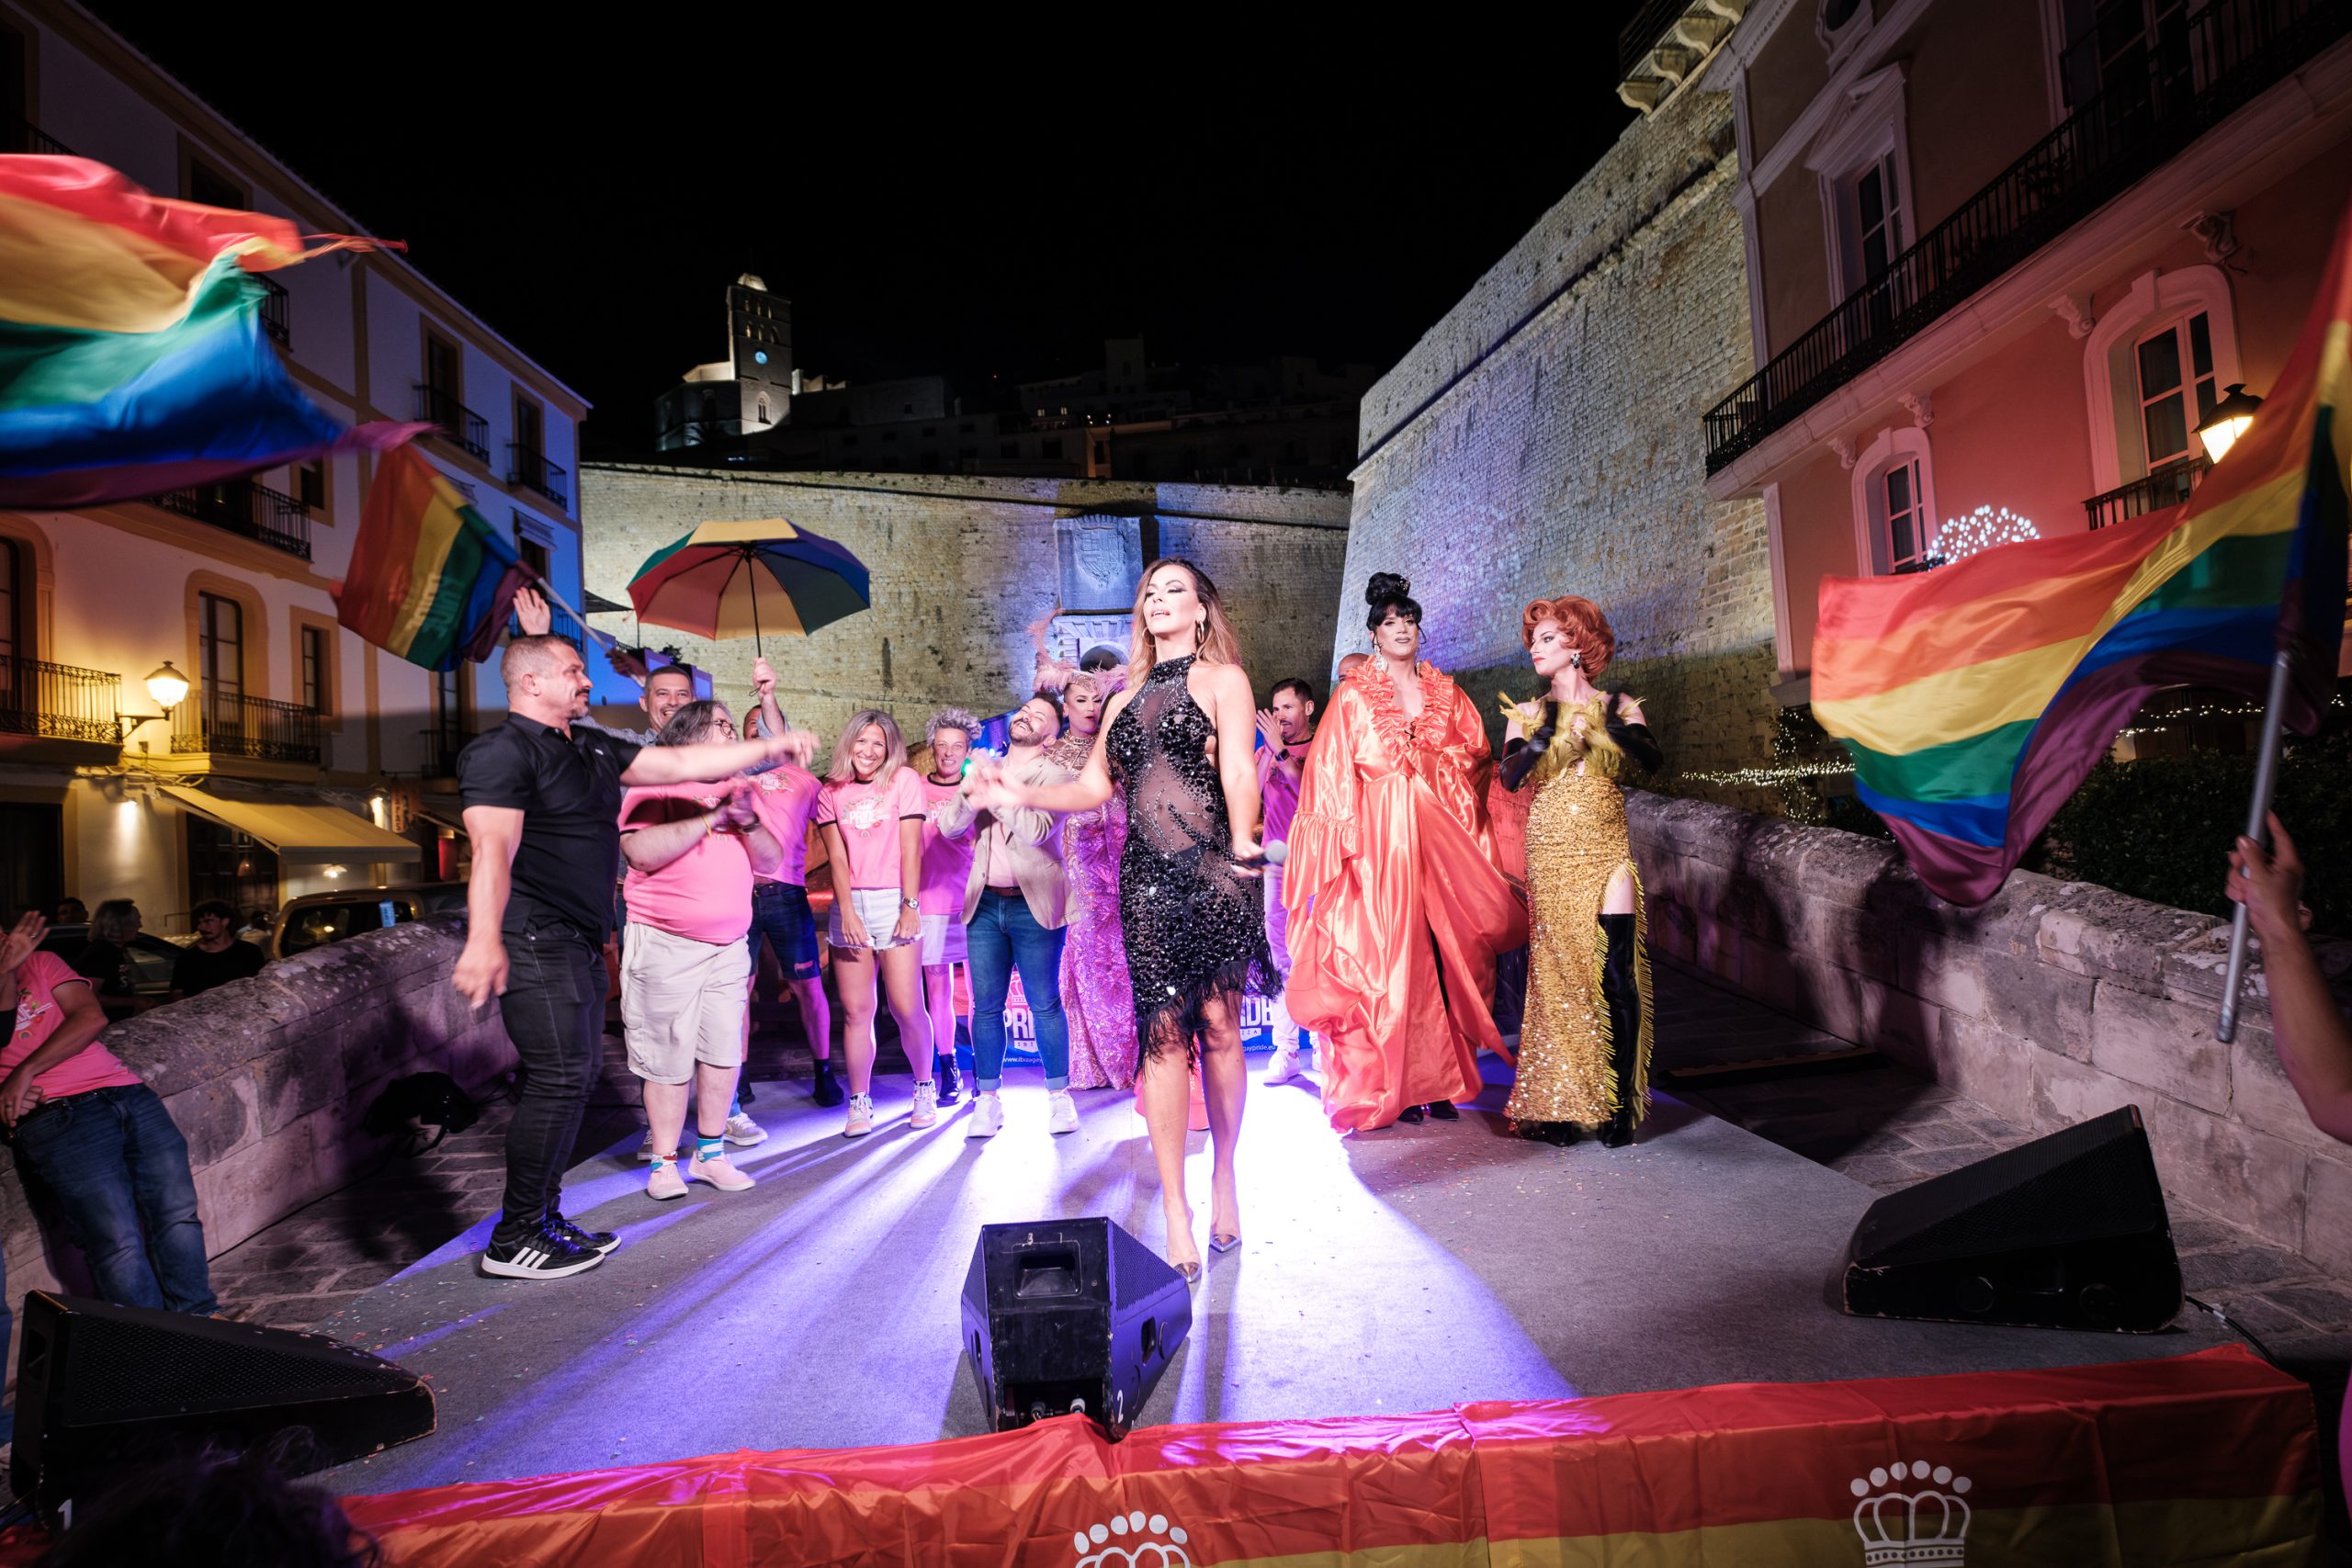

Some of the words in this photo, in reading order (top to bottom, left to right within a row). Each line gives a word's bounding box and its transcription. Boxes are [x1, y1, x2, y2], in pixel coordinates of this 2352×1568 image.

[1003, 1007, 1035, 1039] PRI
[1117, 1389, 1125, 1425] 2
[57, 1497, 73, 1531] 1
